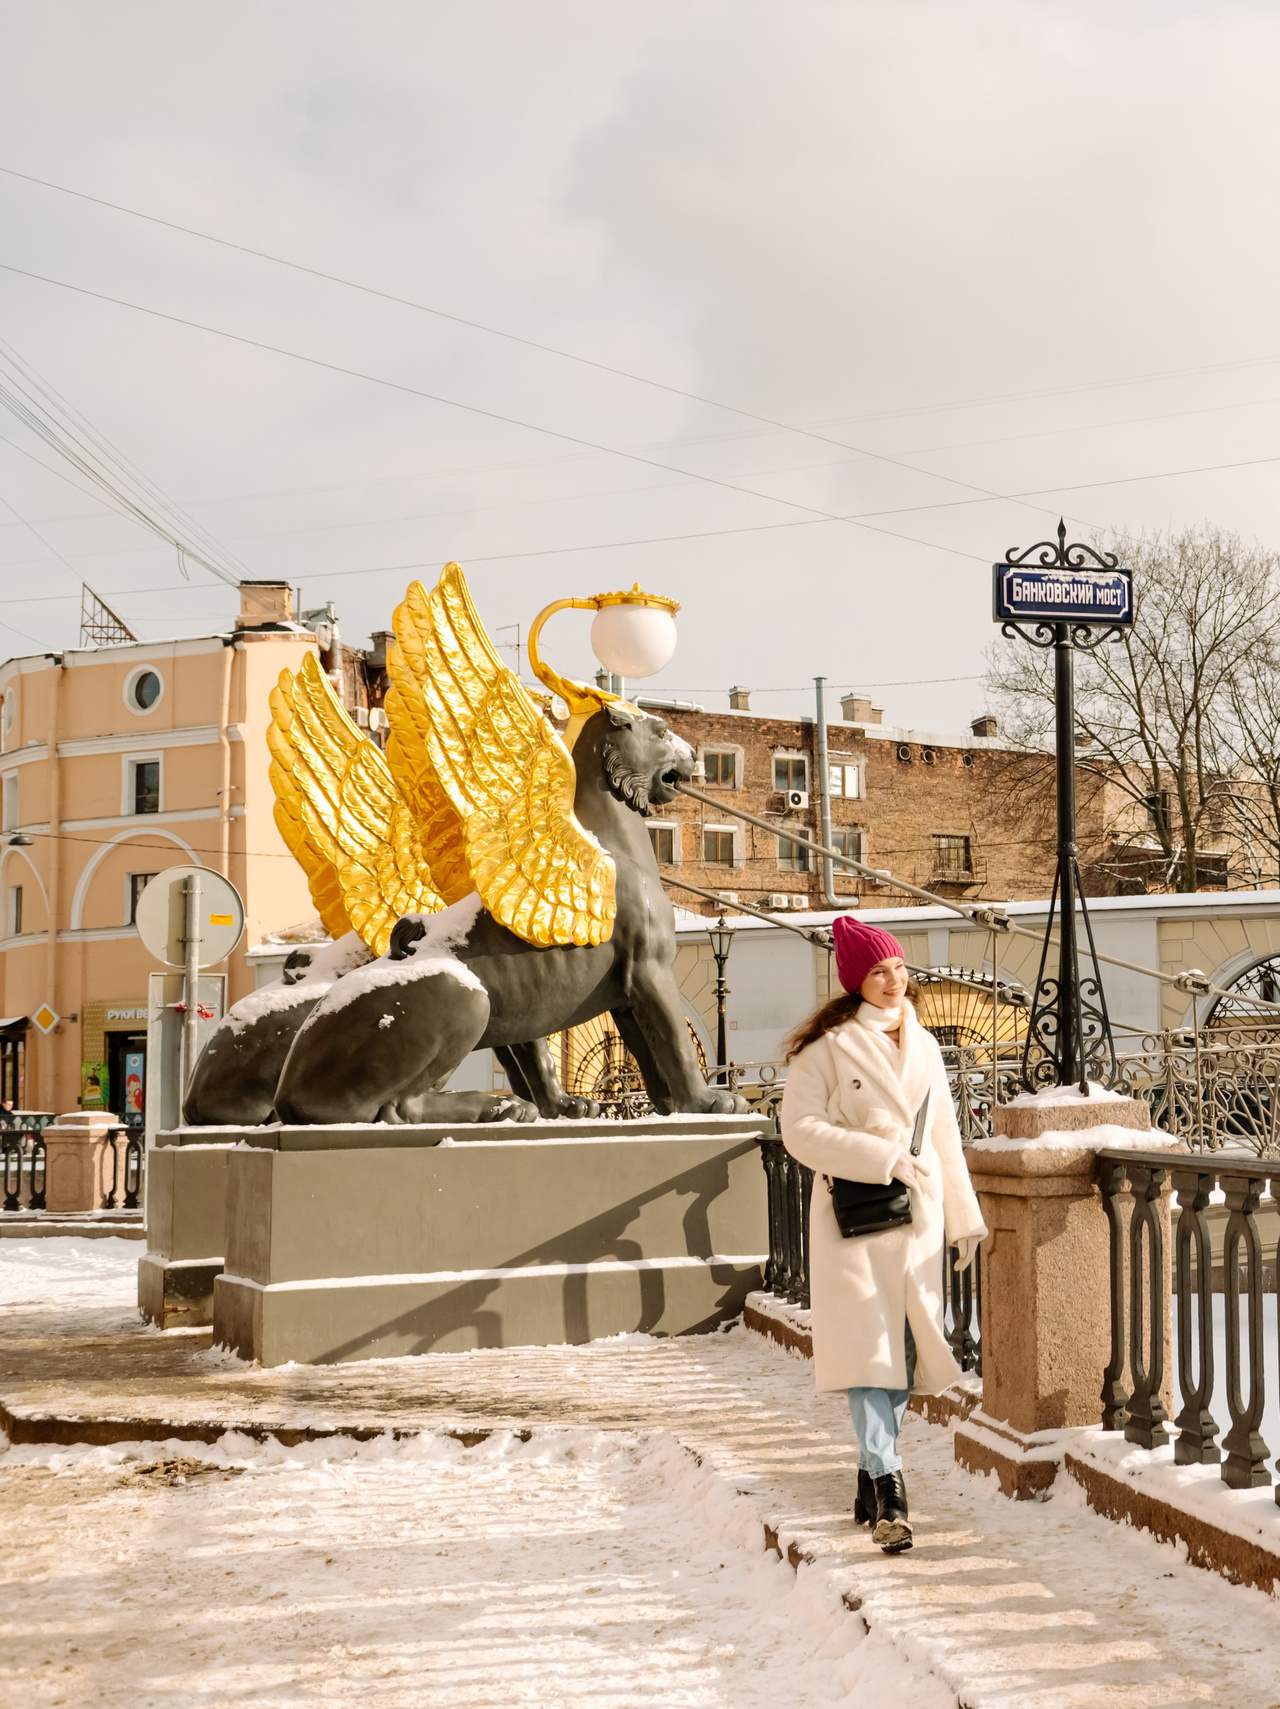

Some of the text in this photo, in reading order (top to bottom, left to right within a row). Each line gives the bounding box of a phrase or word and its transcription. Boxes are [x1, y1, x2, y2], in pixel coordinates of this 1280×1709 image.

[1012, 577, 1122, 606] БАНКОВСКИЙ МОСТ
[107, 1010, 135, 1020] РУКИ
